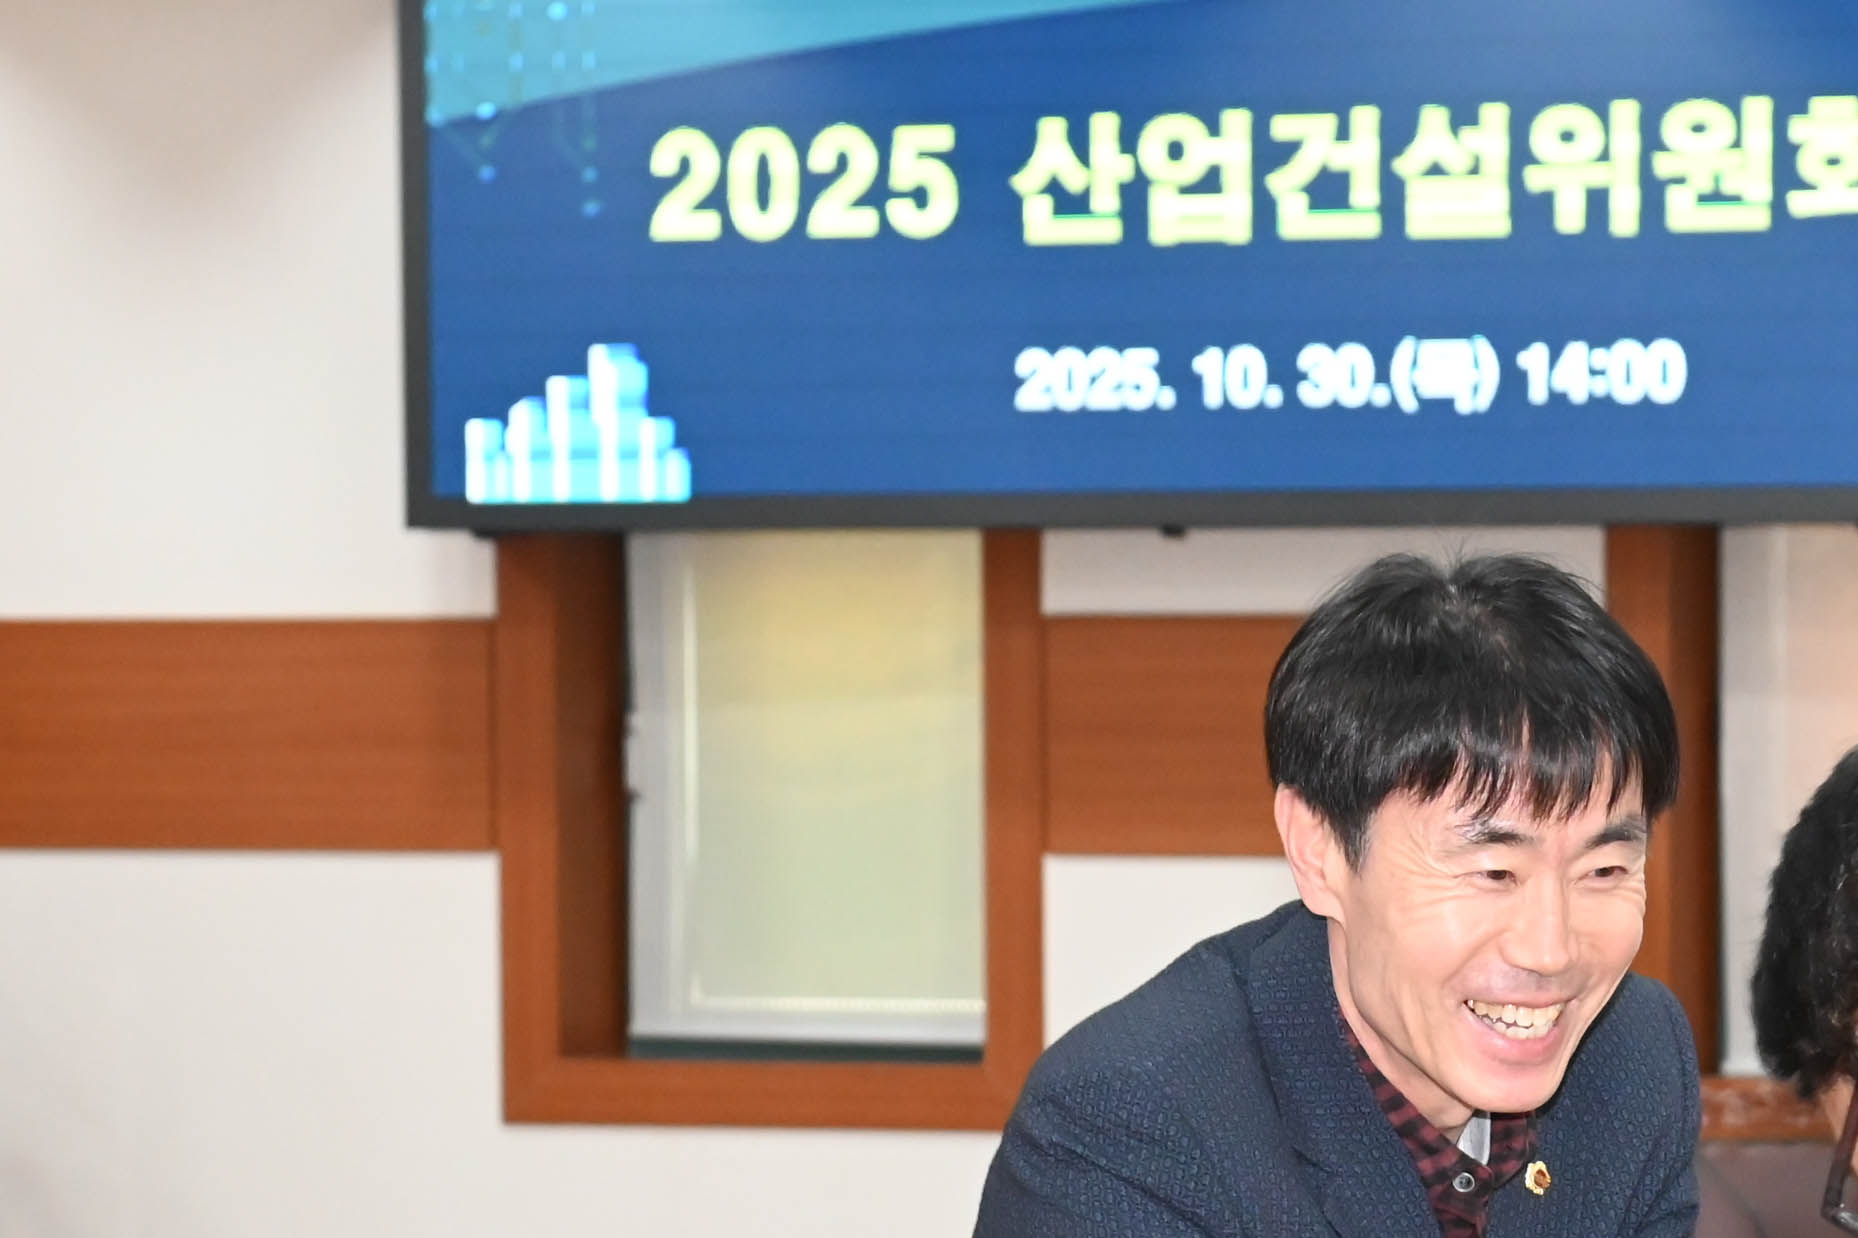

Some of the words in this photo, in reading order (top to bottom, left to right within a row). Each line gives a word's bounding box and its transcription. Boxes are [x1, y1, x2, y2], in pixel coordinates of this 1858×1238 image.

[649, 124, 958, 242] 2025
[1014, 346, 1176, 411] 2025.
[1192, 344, 1283, 409] 10.
[1516, 338, 1687, 404] 14:00
